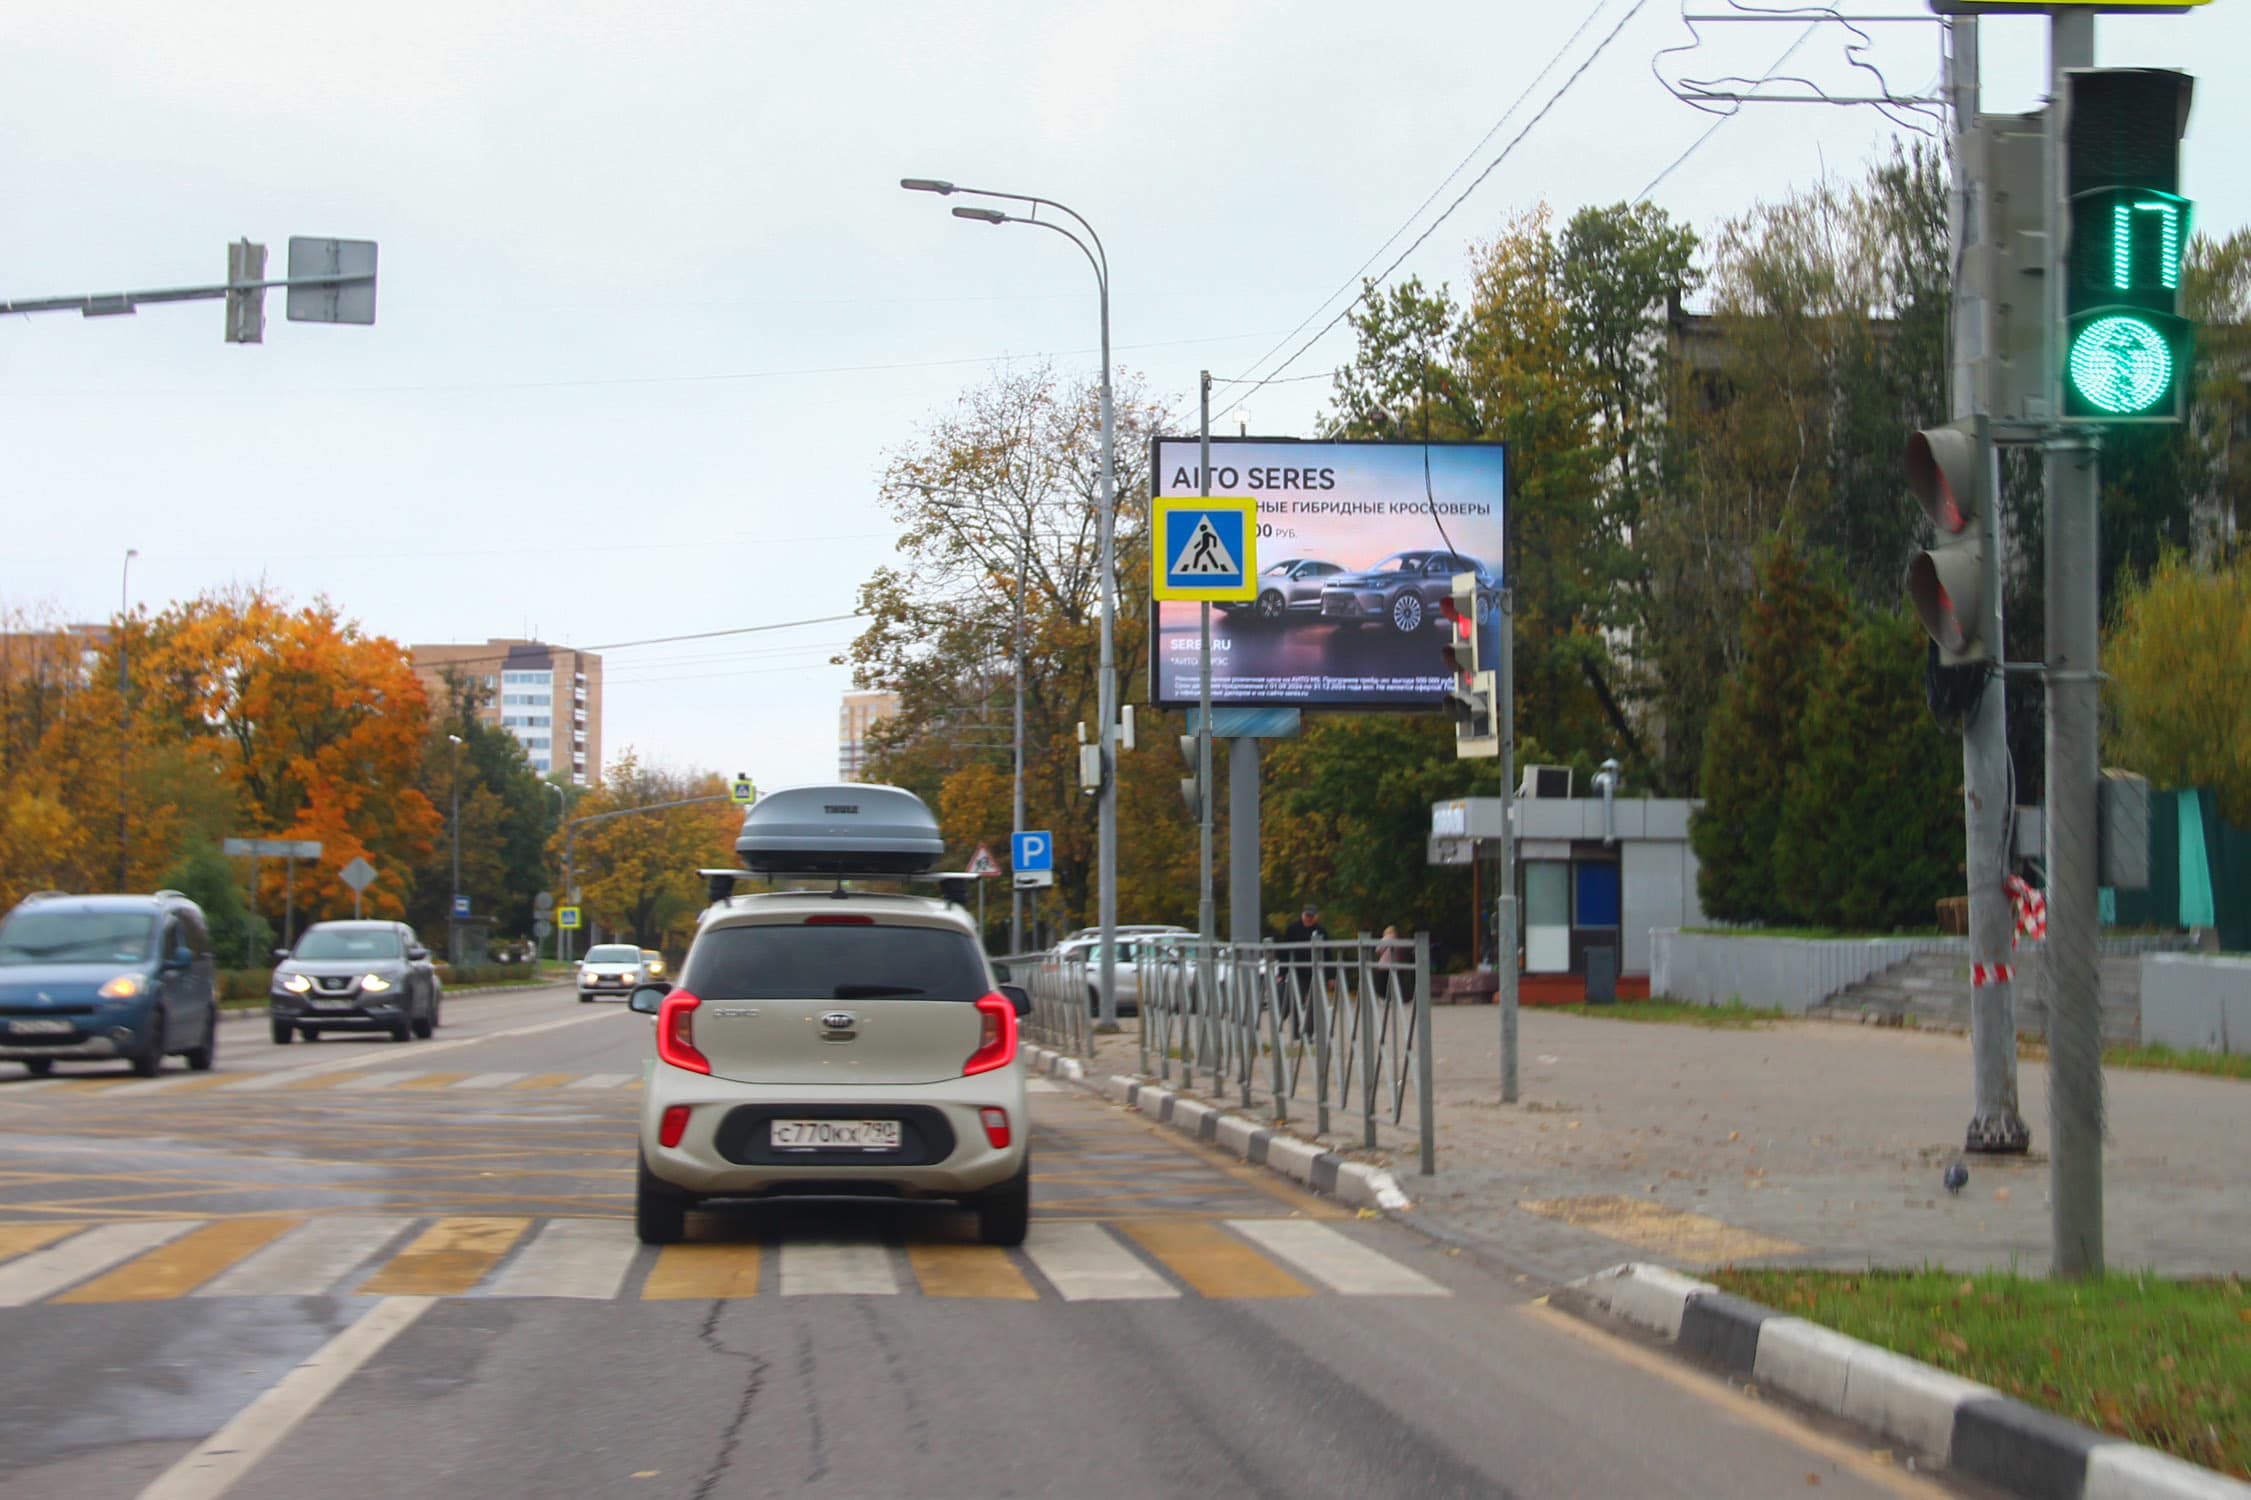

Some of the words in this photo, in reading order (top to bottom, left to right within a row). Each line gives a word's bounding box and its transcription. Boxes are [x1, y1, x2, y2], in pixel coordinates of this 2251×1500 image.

[2112, 200, 2179, 291] 17
[1171, 466, 1239, 489] AITO
[1247, 467, 1336, 490] SERES
[1256, 501, 1288, 513] НЫЕ
[1292, 501, 1384, 516] ГИБРИДНЫЕ
[1389, 502, 1491, 516] КРОССОВЕРЫ
[1170, 639, 1232, 651] SERE.RU
[1022, 836, 1046, 868] P
